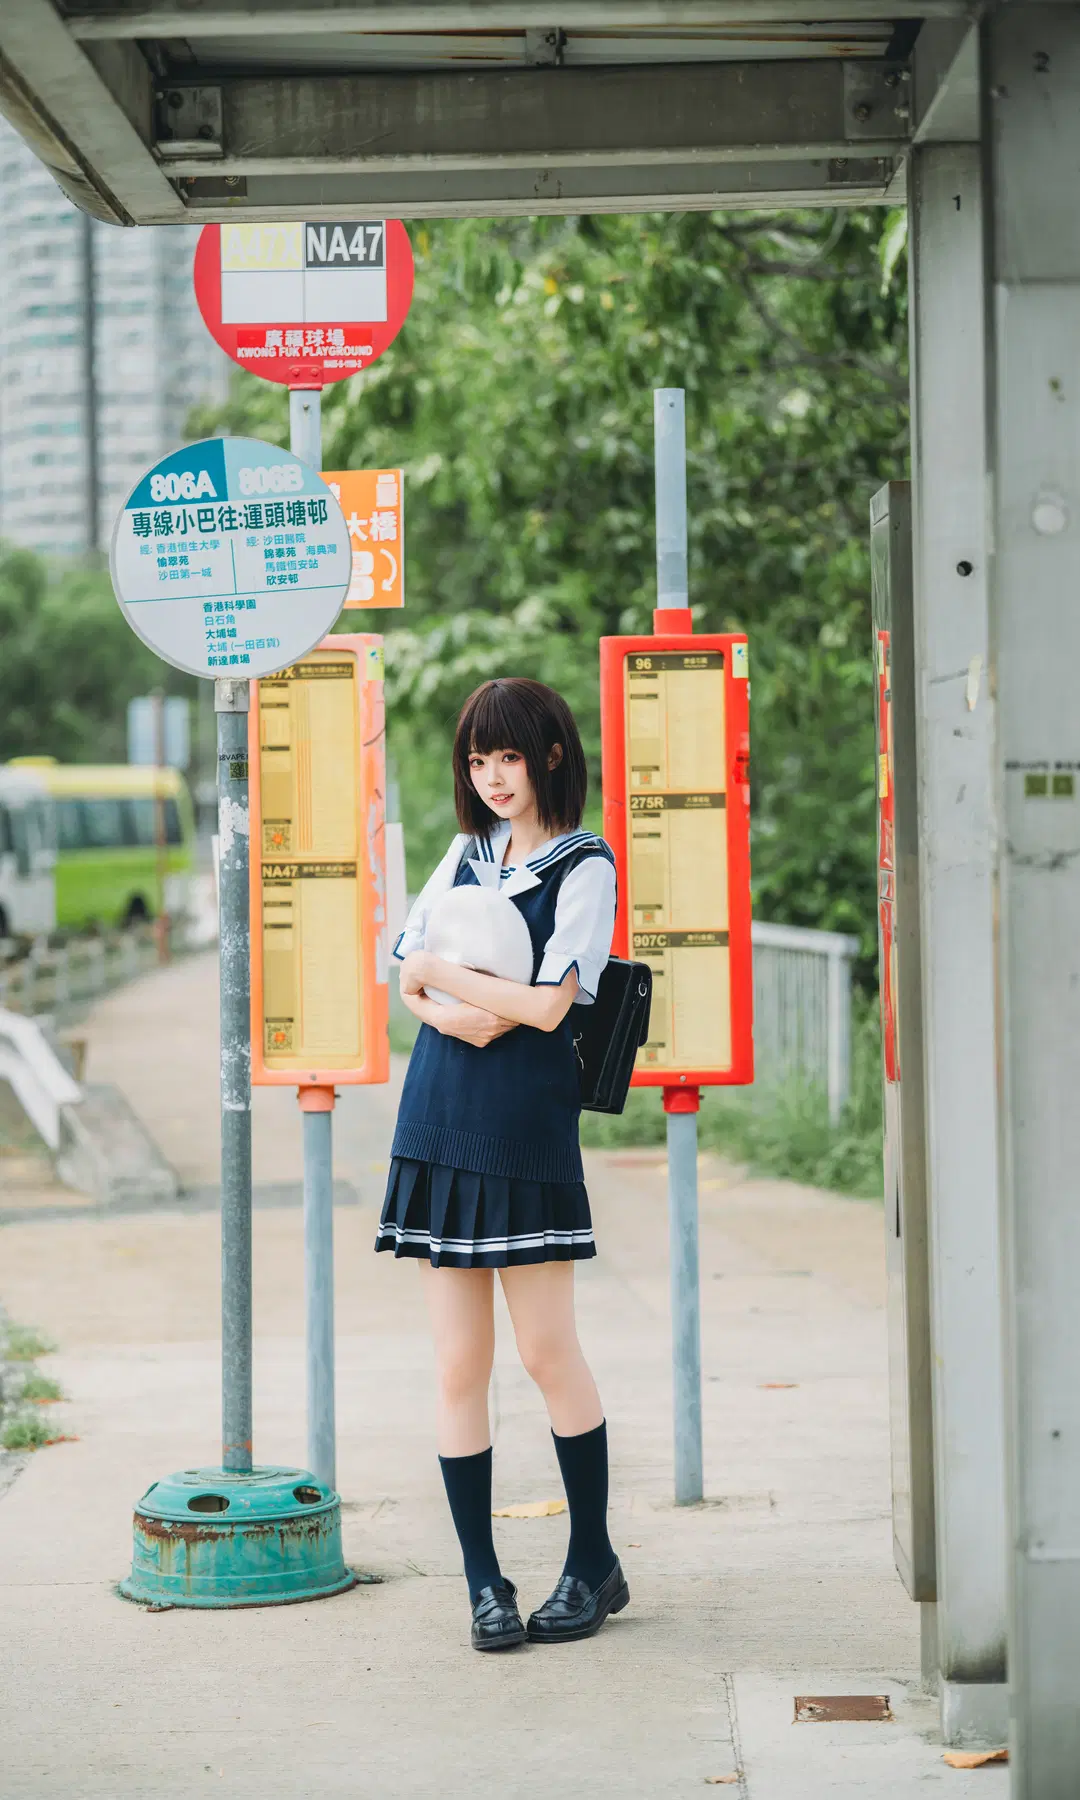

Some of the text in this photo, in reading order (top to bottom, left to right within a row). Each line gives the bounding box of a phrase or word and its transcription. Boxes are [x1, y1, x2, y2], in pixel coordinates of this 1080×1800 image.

[952, 193, 962, 212] 1
[225, 226, 383, 263] A47X NA47
[265, 329, 345, 347] 廣福球場
[237, 345, 373, 358] KWONG FUK PLAYGROUND
[150, 470, 217, 502] 806A
[238, 464, 304, 495] 806B
[203, 599, 257, 613] 香港科學園
[204, 614, 236, 626] 白石角
[205, 627, 238, 640] 大埔墟
[635, 658, 652, 669] 96
[631, 796, 664, 809] 275R
[262, 865, 299, 878] NA47
[633, 934, 667, 947] 907C
